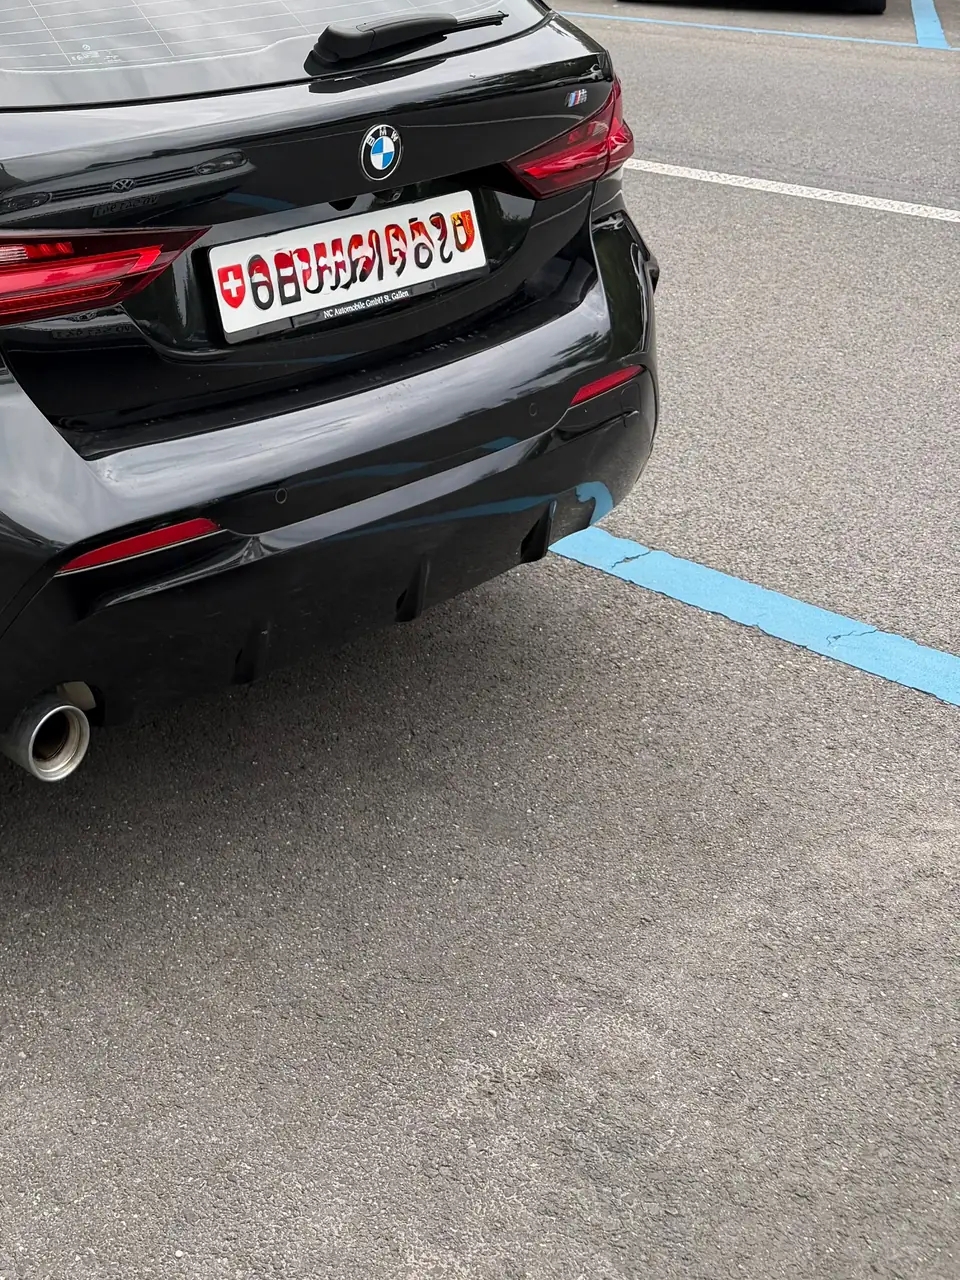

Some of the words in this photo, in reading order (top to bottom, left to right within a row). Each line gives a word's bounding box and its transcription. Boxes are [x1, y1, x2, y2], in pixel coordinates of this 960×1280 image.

[323, 308, 334, 319] NC
[334, 300, 366, 316] Automobile
[365, 297, 384, 308] GmbH
[391, 290, 410, 300] Gallen
